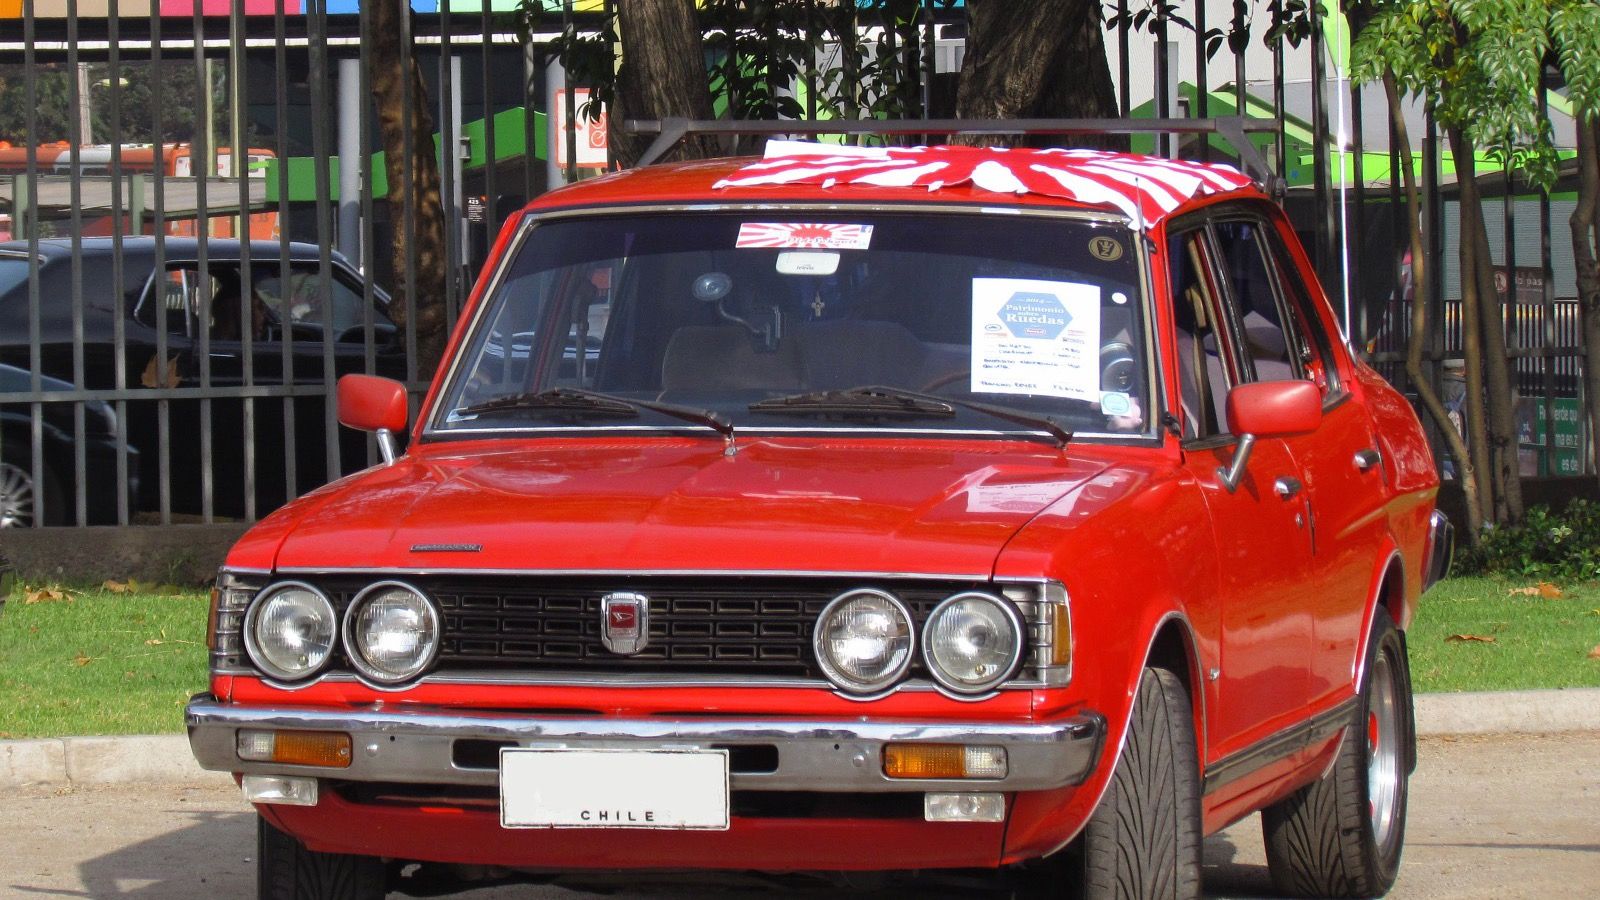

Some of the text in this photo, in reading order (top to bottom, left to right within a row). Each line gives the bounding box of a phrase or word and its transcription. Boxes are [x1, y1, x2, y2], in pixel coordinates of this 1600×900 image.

[1526, 278, 1543, 287] pas
[1005, 304, 1065, 314] Patrimonio
[1006, 313, 1065, 326] Ruedas
[580, 810, 655, 822] CHILE
